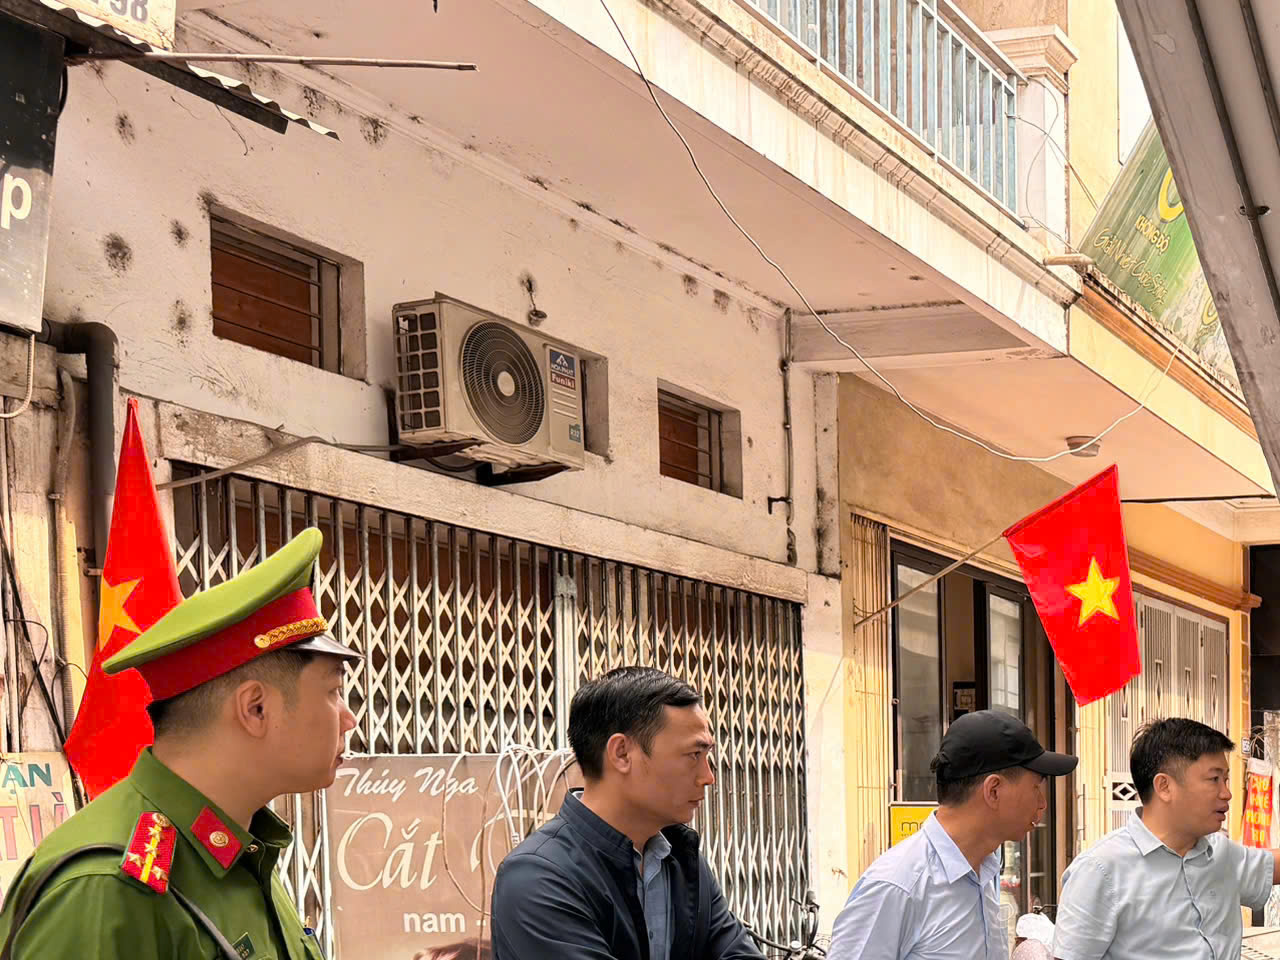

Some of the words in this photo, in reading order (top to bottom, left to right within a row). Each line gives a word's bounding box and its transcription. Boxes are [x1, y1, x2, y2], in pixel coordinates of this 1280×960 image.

[414, 767, 480, 802] Nga
[336, 812, 443, 891] Cắt
[403, 911, 466, 933] nam
